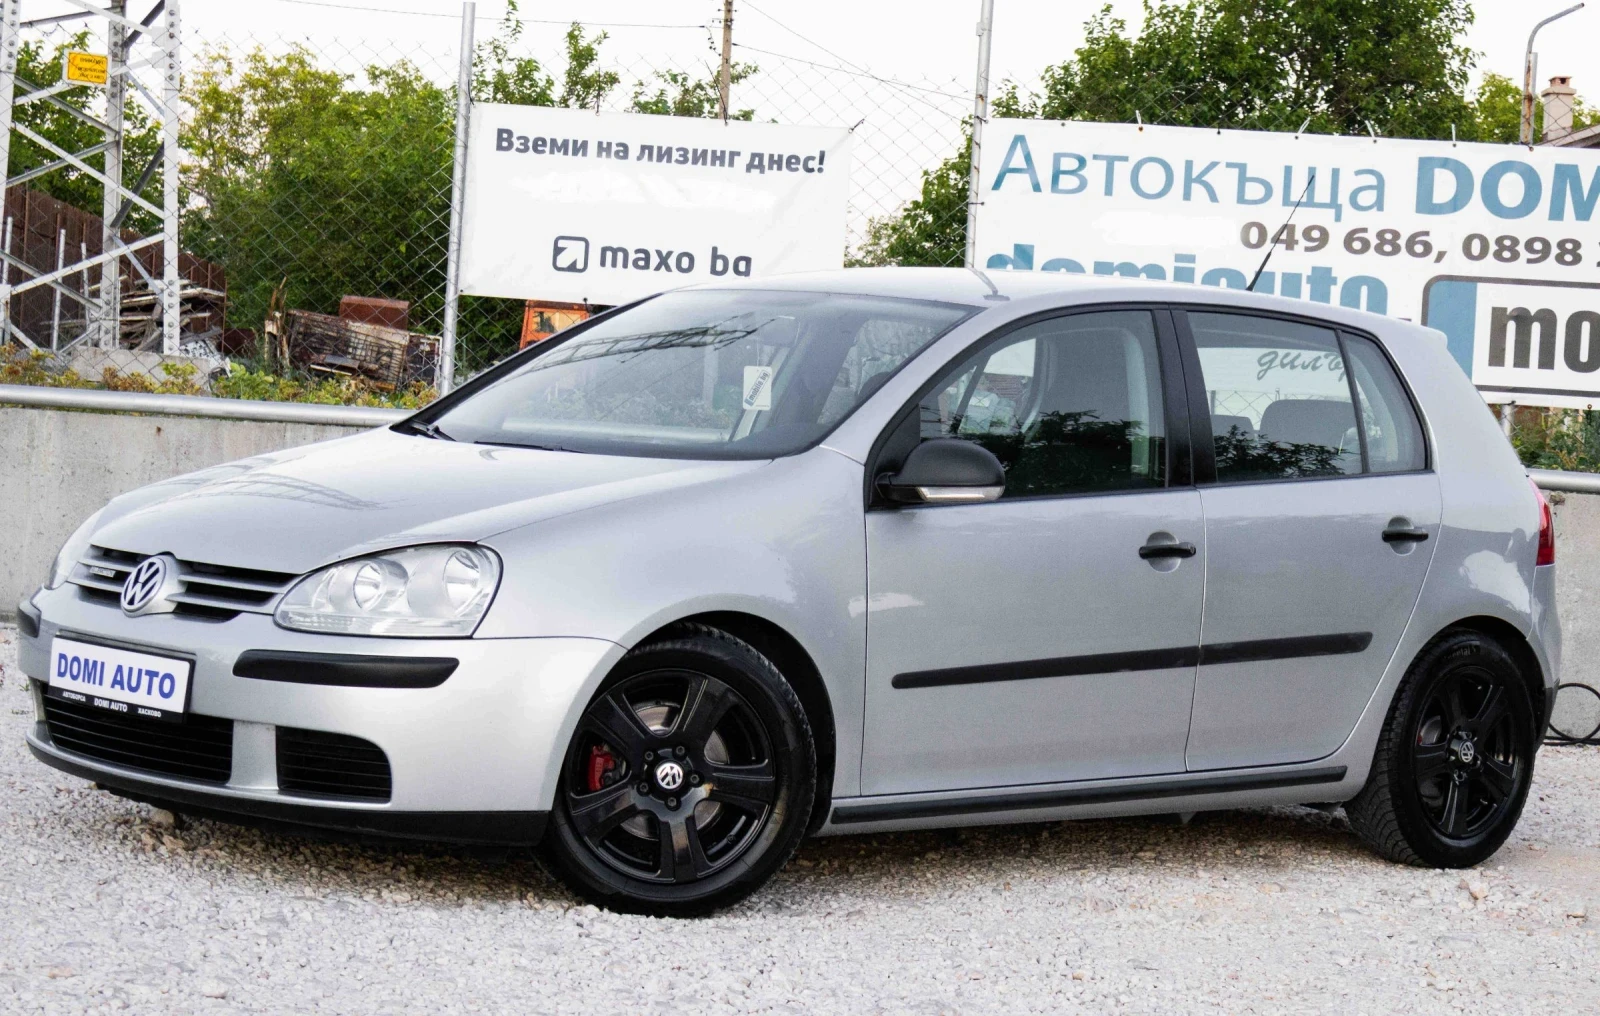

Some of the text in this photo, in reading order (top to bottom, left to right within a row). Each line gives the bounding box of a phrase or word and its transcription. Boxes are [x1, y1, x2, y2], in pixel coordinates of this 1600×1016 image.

[496, 128, 825, 175] Вземи на лизинг днес!
[991, 133, 1386, 223] Автокъща
[600, 246, 694, 273] maxo
[1240, 221, 1330, 252] 049
[1343, 228, 1447, 264] 686,
[1462, 233, 1583, 266] 0898
[1488, 306, 1600, 373] mo
[57, 654, 176, 699] DOMI AUTO
[94, 697, 128, 713] DOMI AUTO
